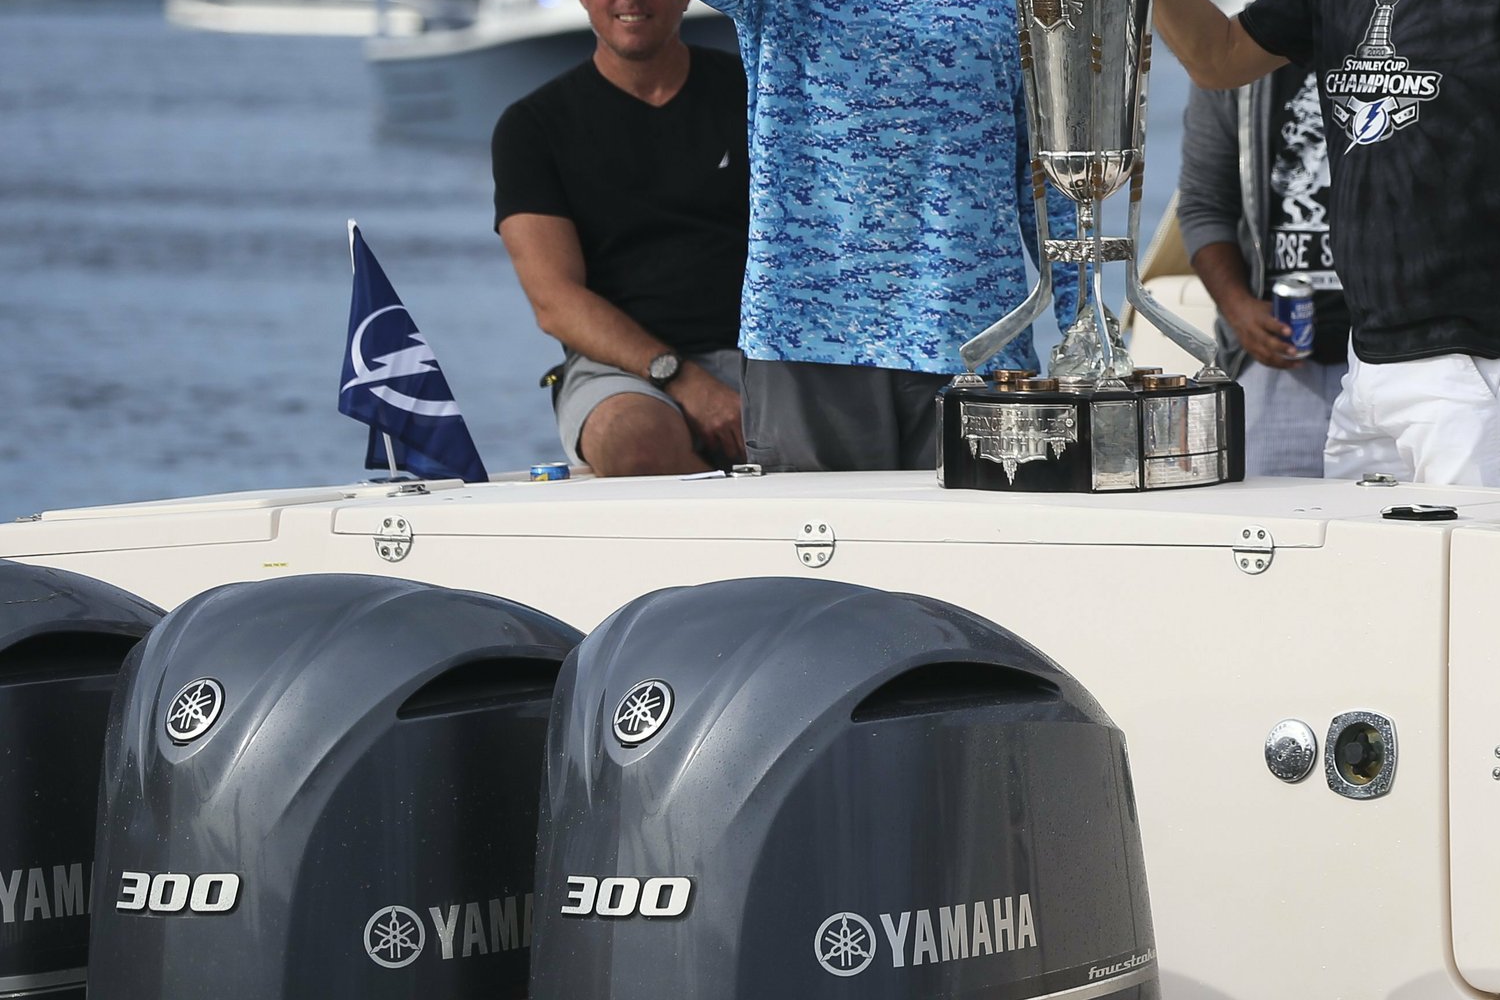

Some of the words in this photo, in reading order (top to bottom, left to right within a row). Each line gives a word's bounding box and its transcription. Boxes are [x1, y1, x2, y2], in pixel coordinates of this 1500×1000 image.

[1344, 59, 1385, 72] STANLEY
[1384, 59, 1406, 73] CUP
[1367, 47, 1385, 58] 2020
[1325, 73, 1437, 96] CHAMPIONS
[1274, 233, 1313, 270] RSE
[116, 871, 241, 912] 300
[561, 875, 693, 917] 300
[880, 893, 1038, 968] YAMAHA
